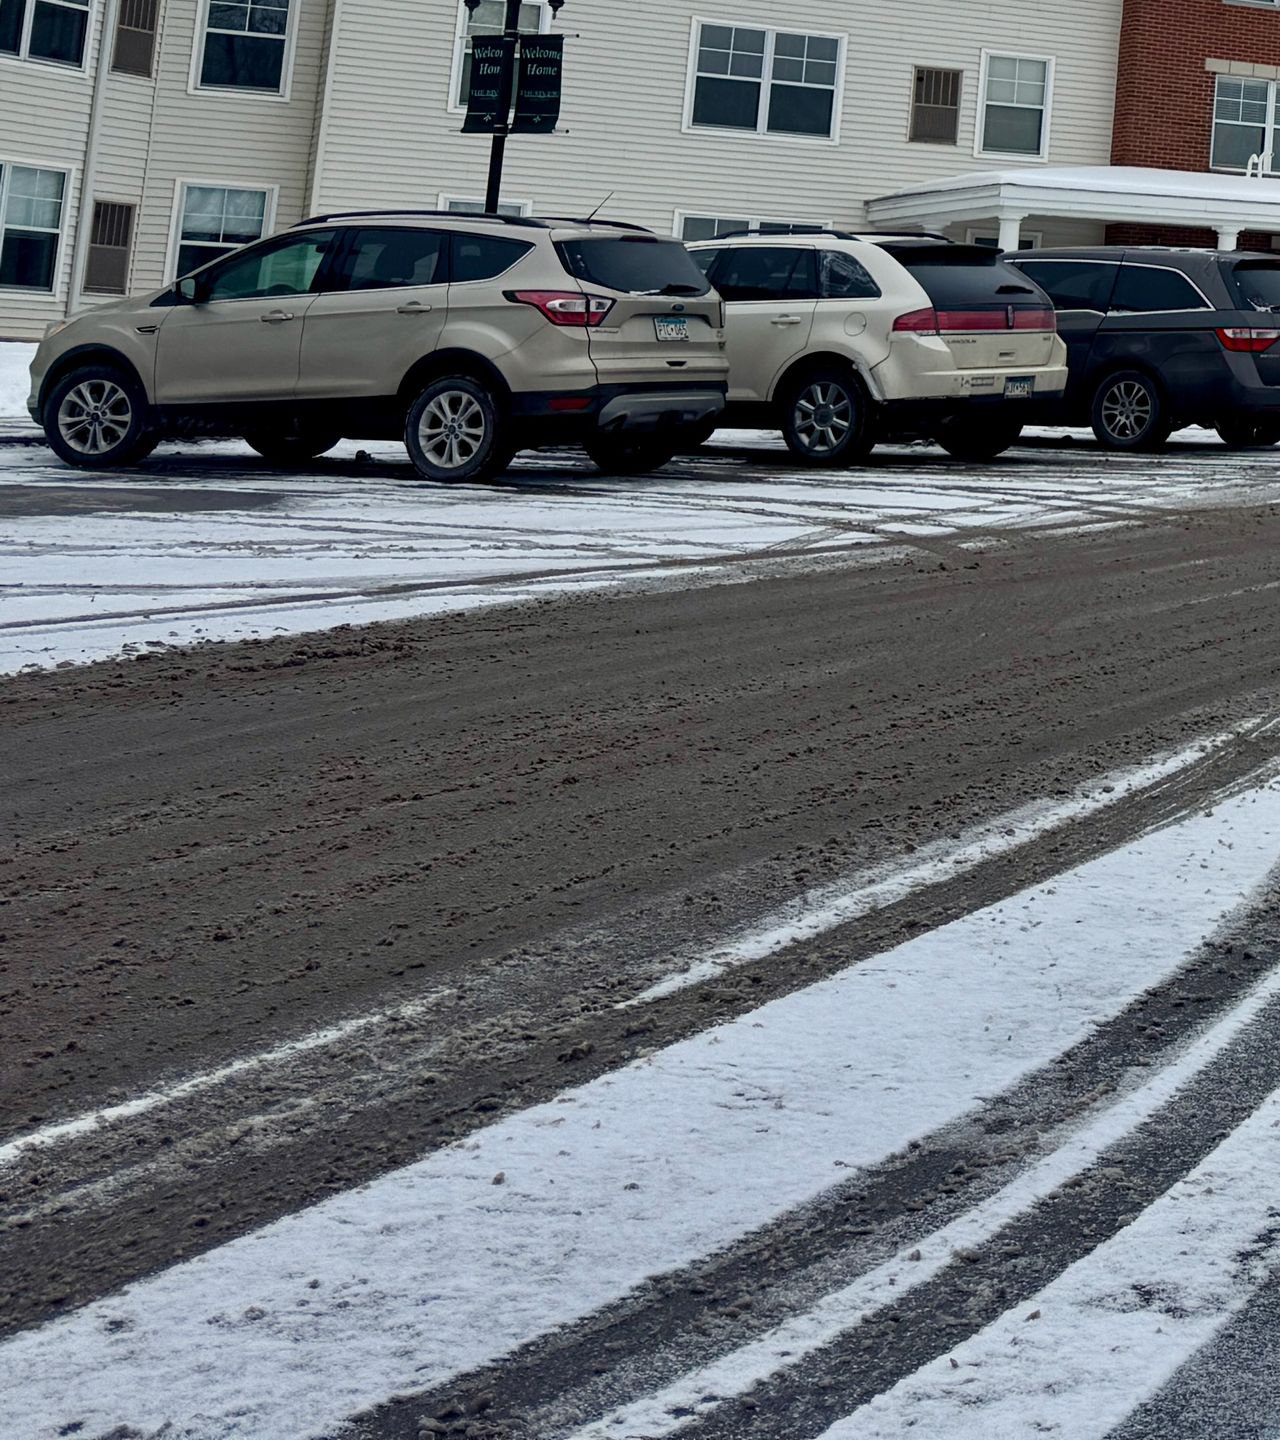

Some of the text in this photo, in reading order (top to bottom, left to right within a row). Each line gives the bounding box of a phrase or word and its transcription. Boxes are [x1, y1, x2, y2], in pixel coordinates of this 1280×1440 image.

[474, 46, 504, 60] Welco
[521, 46, 562, 60] Welcome
[479, 63, 501, 75] Hom
[527, 63, 558, 76] Home
